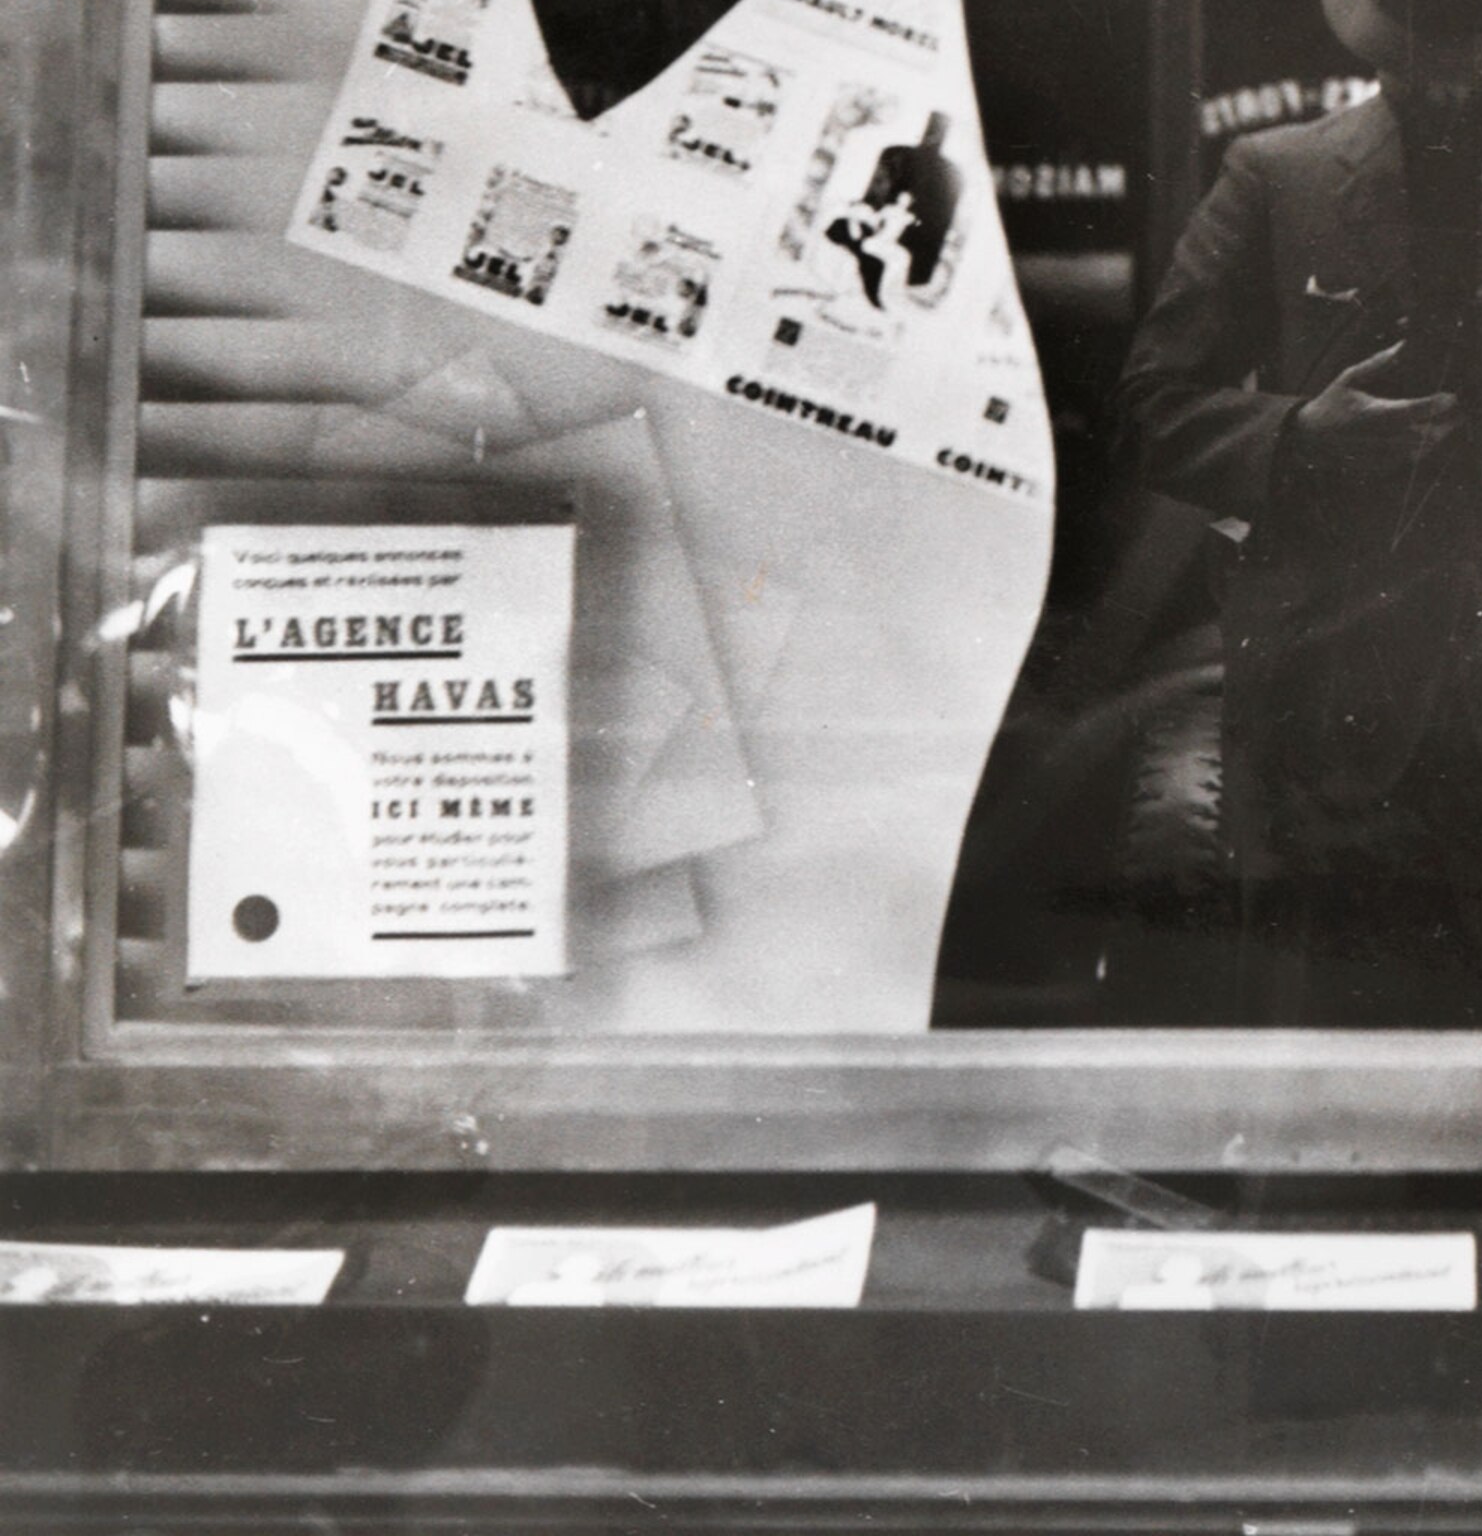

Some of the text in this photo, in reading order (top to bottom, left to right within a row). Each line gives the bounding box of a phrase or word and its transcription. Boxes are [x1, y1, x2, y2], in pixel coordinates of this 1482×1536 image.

[726, 375, 899, 450] COINTREAU
[233, 612, 465, 650] L'AGENCE
[372, 678, 536, 712] HAVAS
[371, 798, 420, 821] ICI
